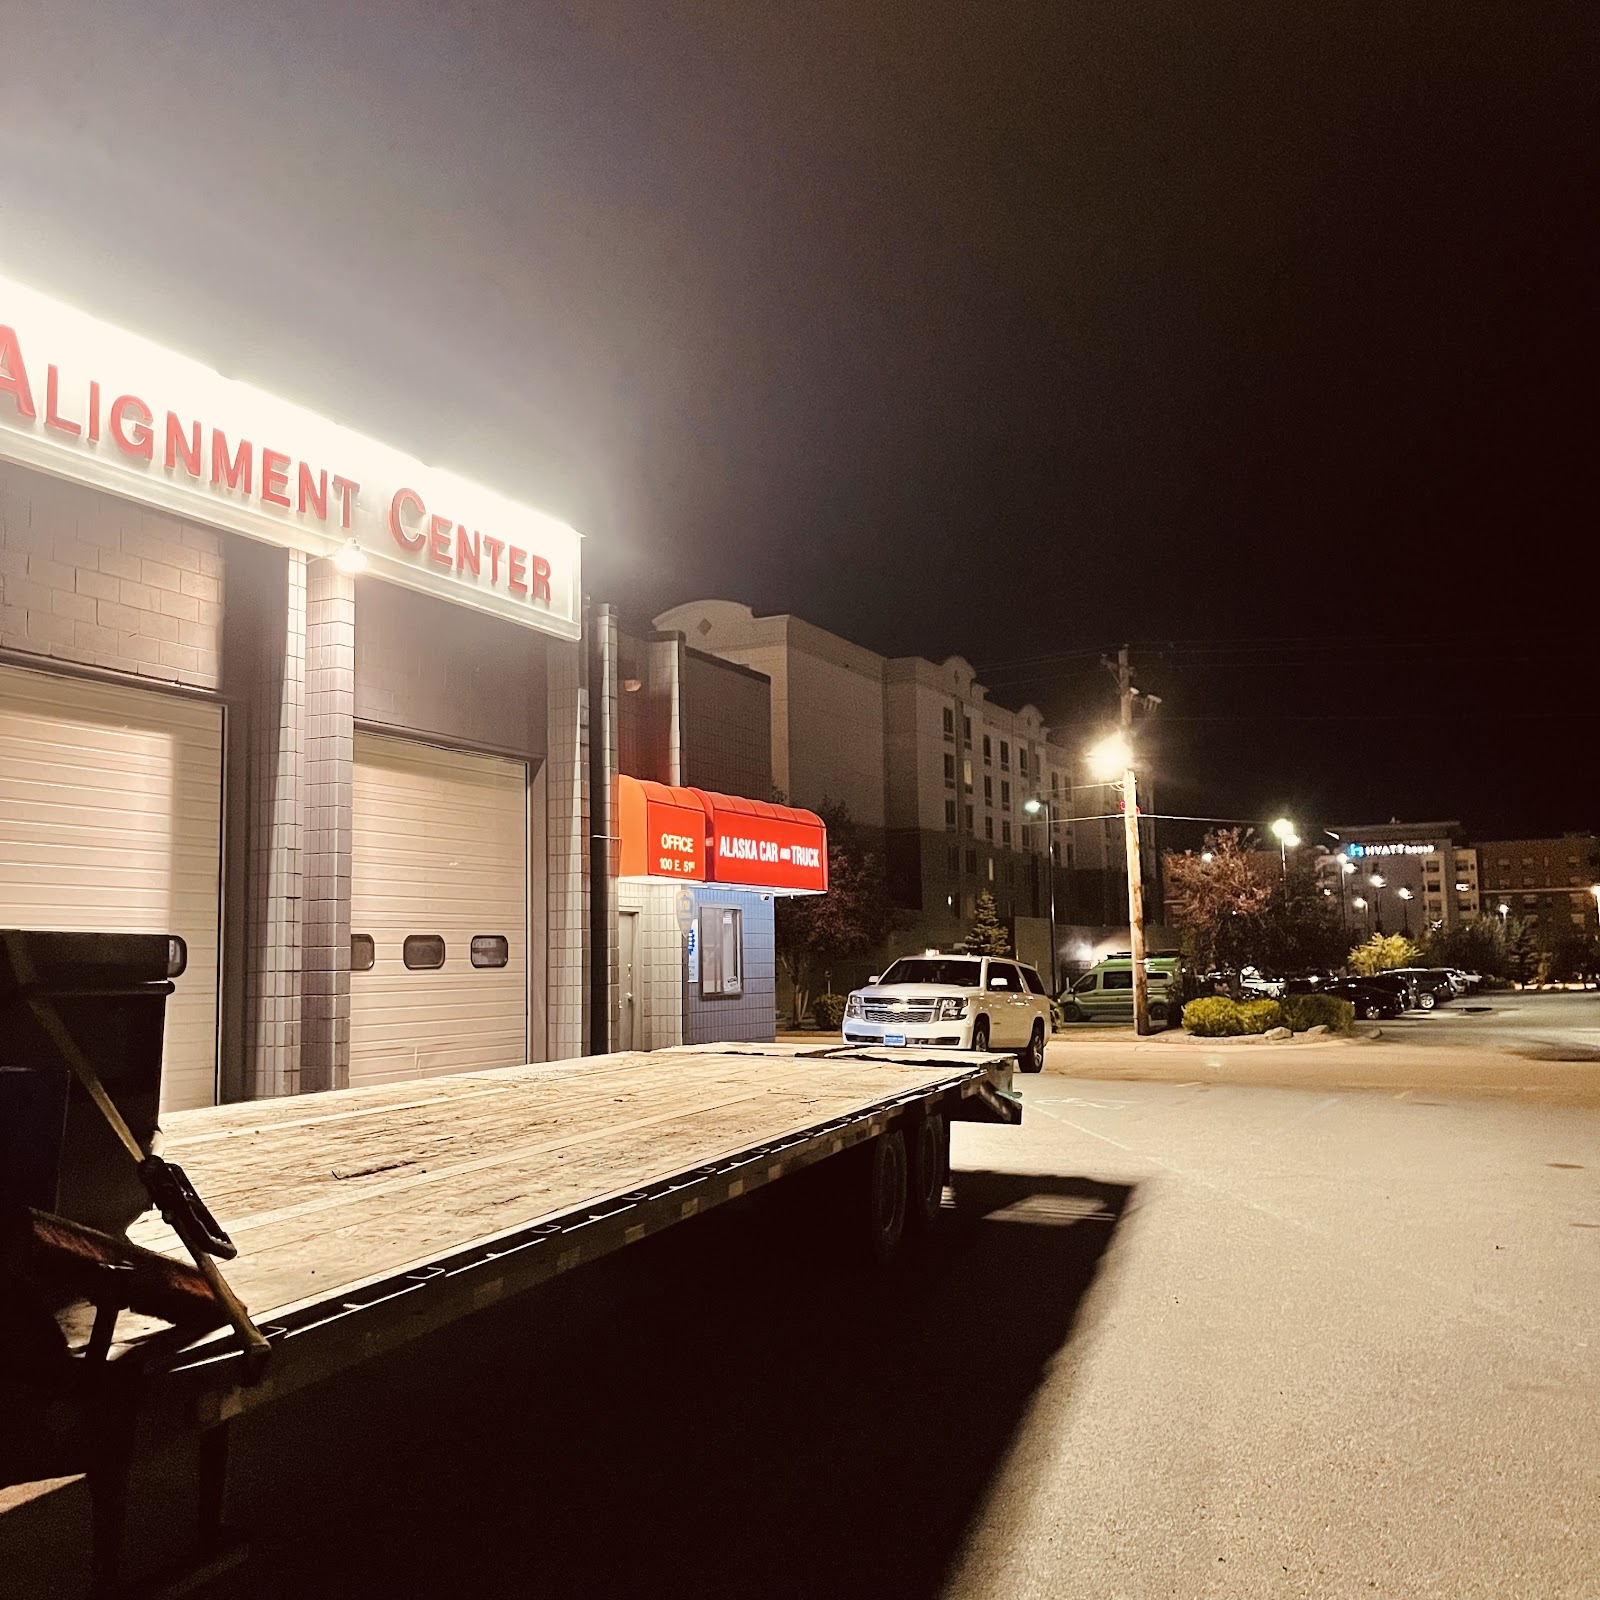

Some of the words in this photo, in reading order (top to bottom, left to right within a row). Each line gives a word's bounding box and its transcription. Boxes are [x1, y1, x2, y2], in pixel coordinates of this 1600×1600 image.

[0, 324, 360, 529] ALIGNMENT
[389, 488, 552, 602] CENTER
[661, 833, 694, 853] OFFICE
[719, 836, 758, 860] ALASKA
[759, 841, 779, 862] CAR
[790, 845, 820, 868] TRUCK
[1365, 843, 1405, 856] HYATT
[659, 857, 673, 870] 100
